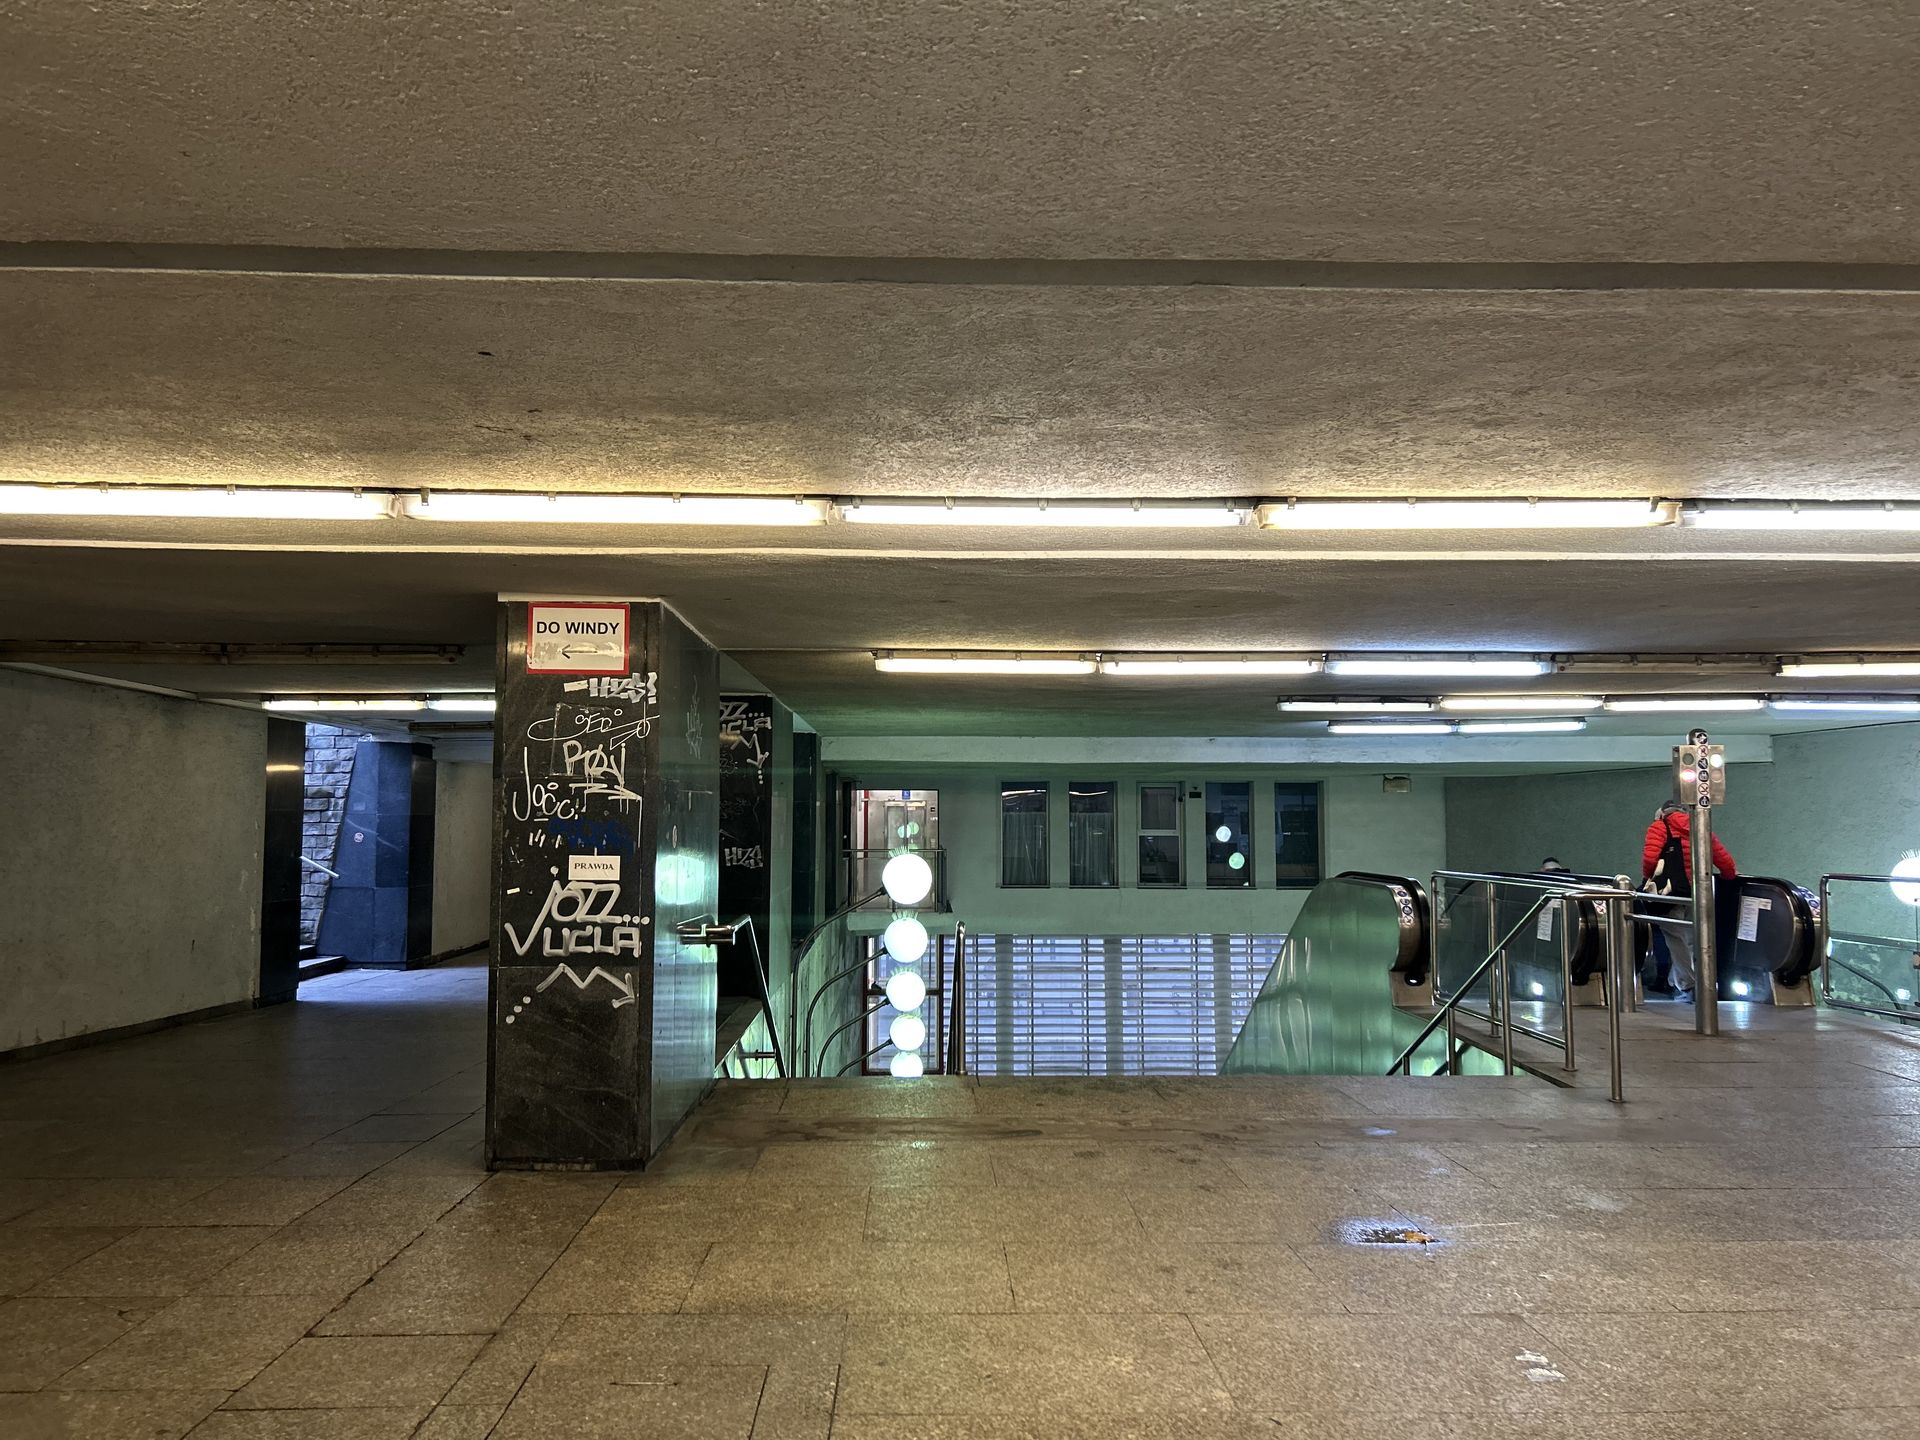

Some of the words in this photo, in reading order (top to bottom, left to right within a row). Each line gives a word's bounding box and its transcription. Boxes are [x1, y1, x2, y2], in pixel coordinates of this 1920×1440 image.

[536, 621, 560, 634] DO
[565, 621, 620, 635] WINDY
[574, 862, 614, 871] PRAWDA
